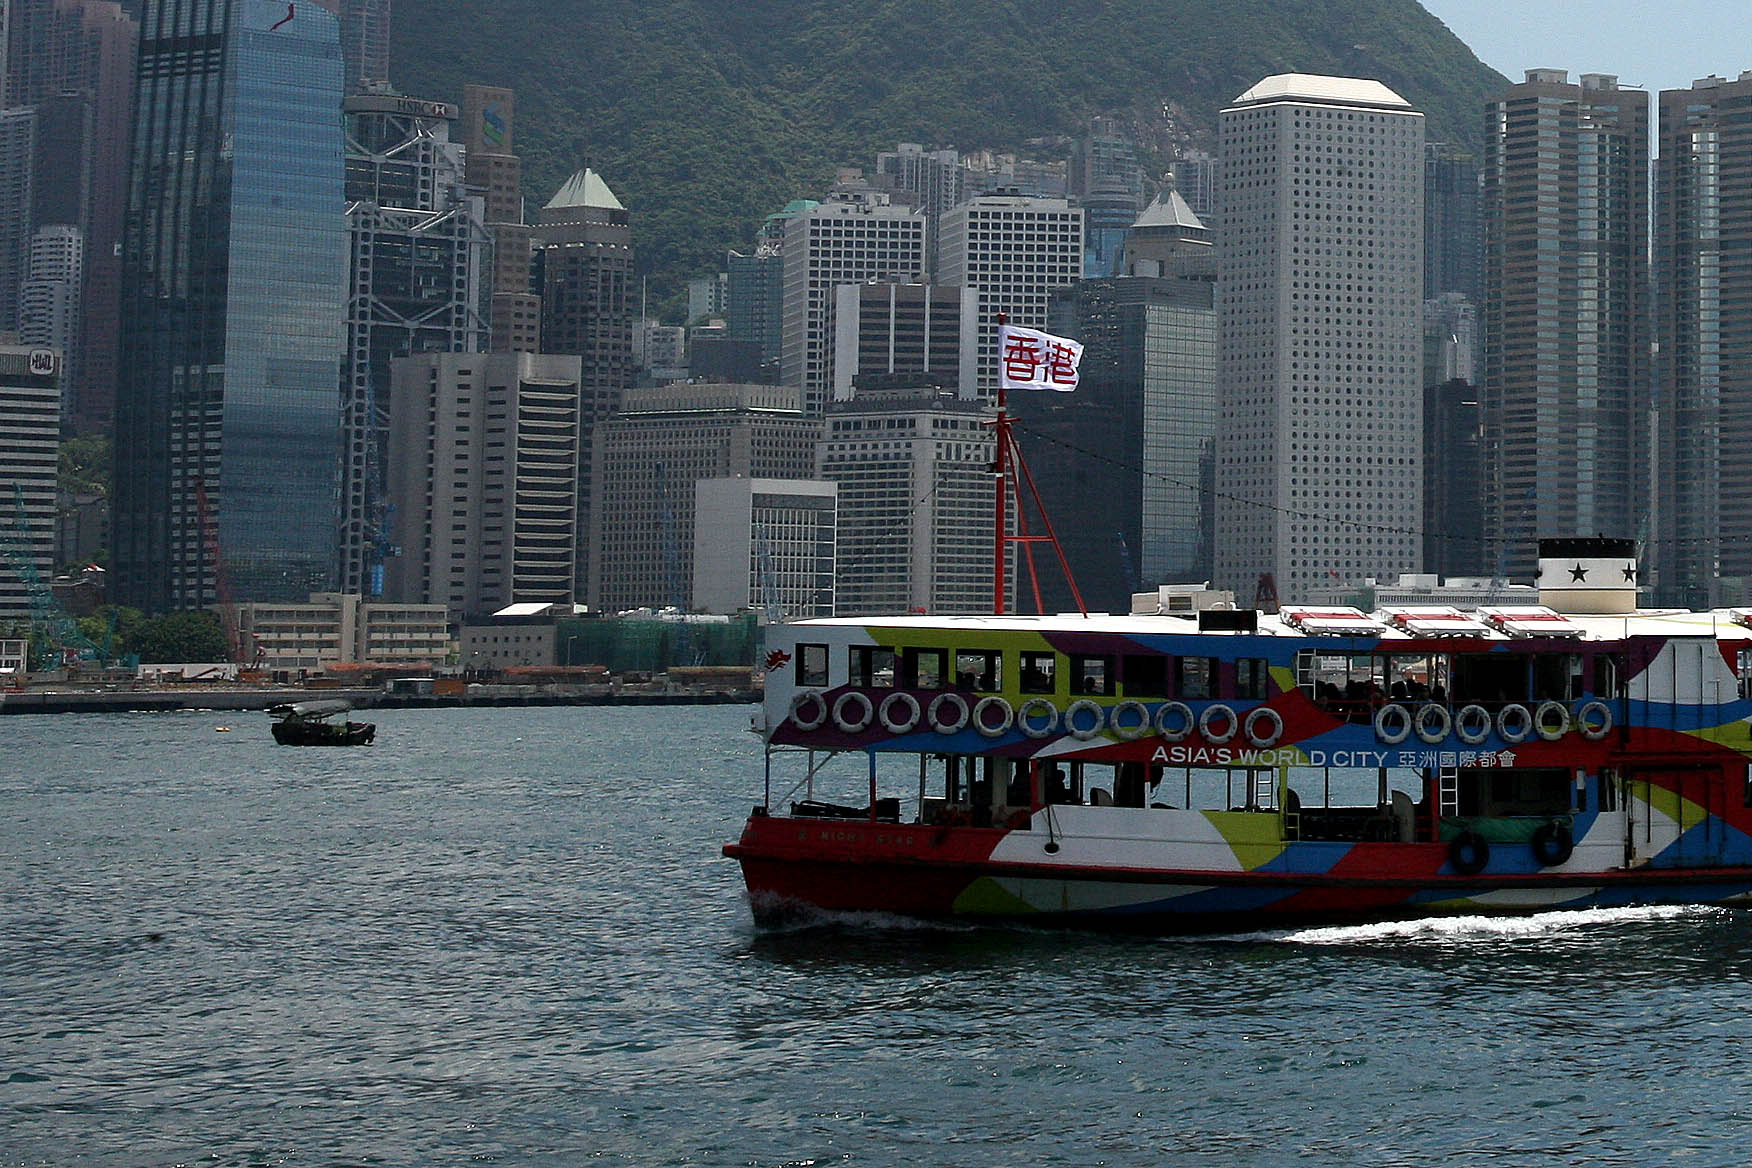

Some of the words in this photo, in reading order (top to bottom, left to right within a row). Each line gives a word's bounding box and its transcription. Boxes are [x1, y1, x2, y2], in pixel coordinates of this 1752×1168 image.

[1003, 335, 1077, 385] 香港
[1151, 745, 1232, 764] ASIA'S
[1239, 749, 1327, 766] WORLD
[1332, 750, 1388, 767] CITY
[1398, 750, 1517, 768] 亞洲國際都會
